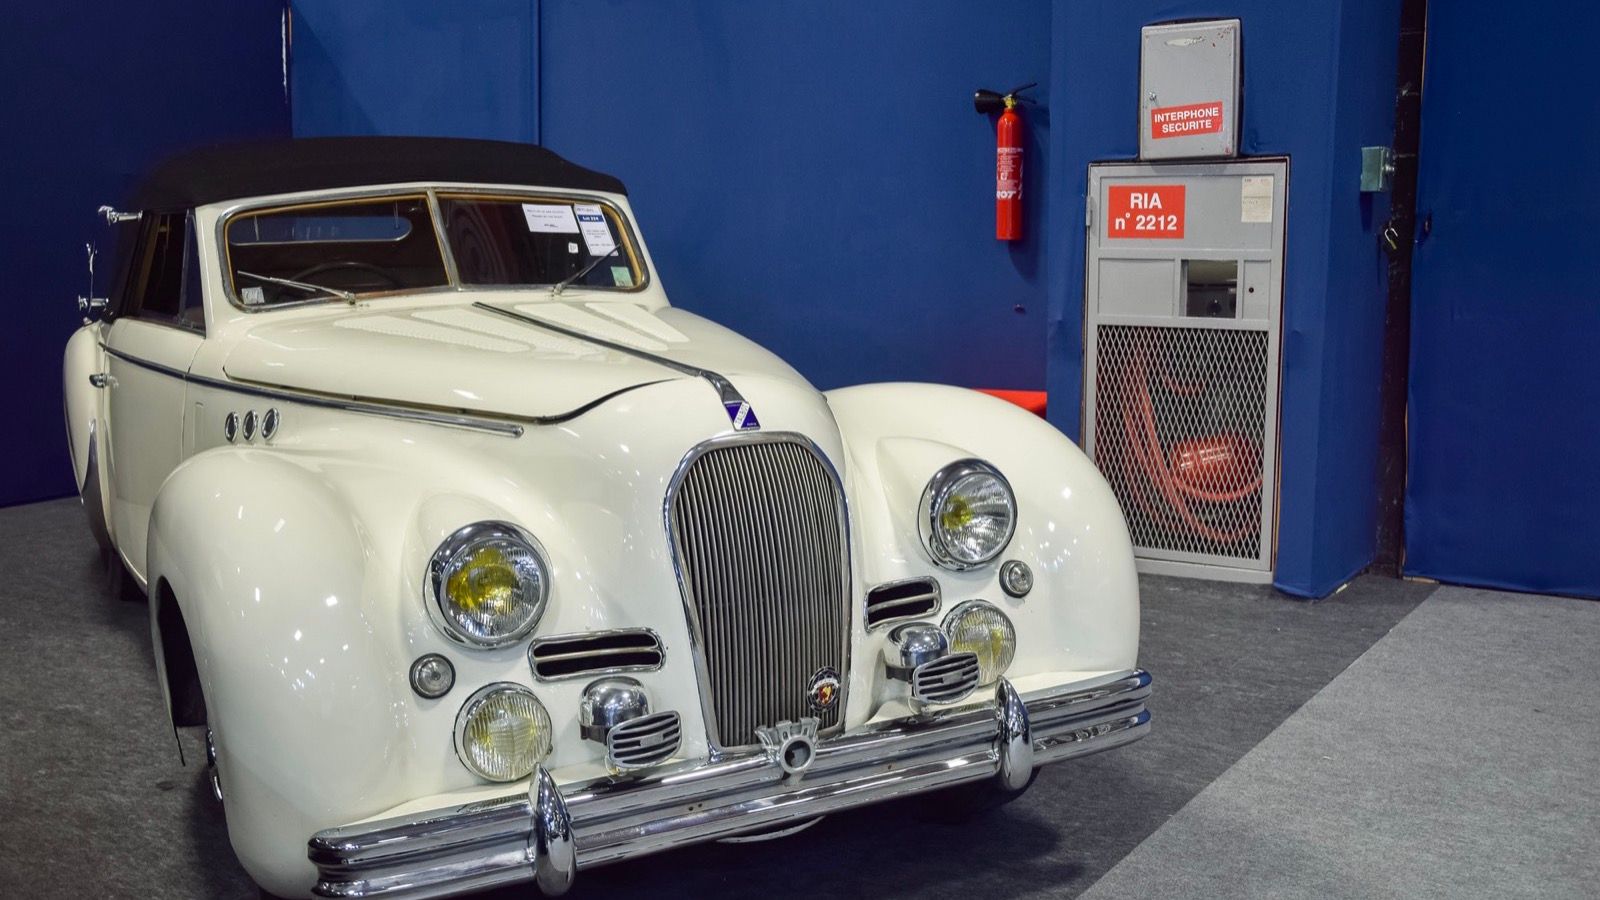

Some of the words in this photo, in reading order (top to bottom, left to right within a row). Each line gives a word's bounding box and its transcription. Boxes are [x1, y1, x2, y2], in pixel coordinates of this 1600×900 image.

[1154, 107, 1219, 122] INTERPHONE
[1162, 120, 1212, 133] SECURITE
[1130, 193, 1162, 209] RIA
[1115, 213, 1130, 230] n°
[1135, 215, 1177, 230] 2212
